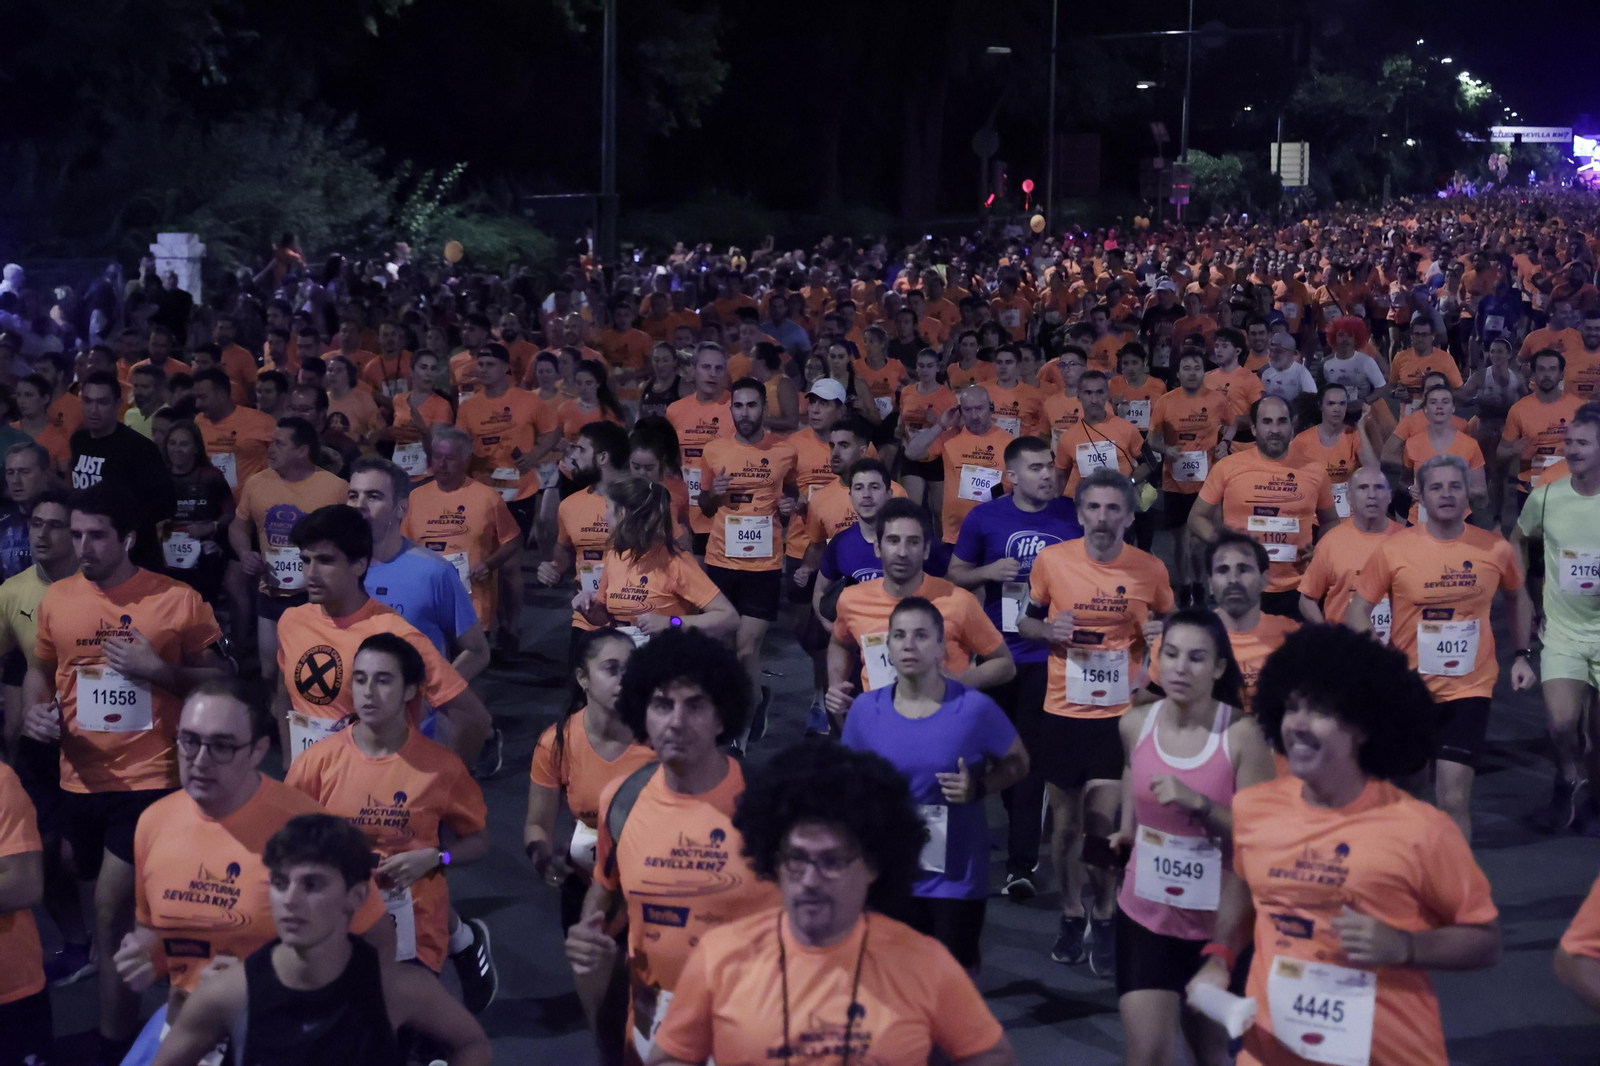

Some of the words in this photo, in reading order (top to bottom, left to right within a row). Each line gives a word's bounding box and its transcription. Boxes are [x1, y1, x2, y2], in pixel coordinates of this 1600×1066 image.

[1088, 453, 1108, 462] 7065
[74, 454, 105, 475] JUST
[1182, 462, 1200, 470] 2663
[72, 471, 89, 489] DO
[971, 477, 990, 488] 7066
[738, 530, 761, 540] 8404
[1263, 533, 1287, 544] 1102
[170, 544, 192, 554] 17455
[1017, 536, 1046, 558] life
[275, 560, 302, 572] 20418
[1571, 566, 1597, 576] 2176
[610, 592, 632, 600] SEVILLA
[1371, 614, 1392, 625] 184
[1436, 640, 1468, 653] 4012
[294, 663, 302, 682] CLUB
[1082, 669, 1119, 683] 15618
[93, 689, 136, 705] 11558
[360, 808, 410, 817] NOCTURNA
[670, 848, 728, 859] NOCTURNA
[644, 856, 694, 870] SEVILLA
[1154, 856, 1204, 880] 10549
[189, 880, 240, 897] NOCTURNA
[162, 890, 210, 904] SEVILLA
[1293, 994, 1344, 1023] 4445
